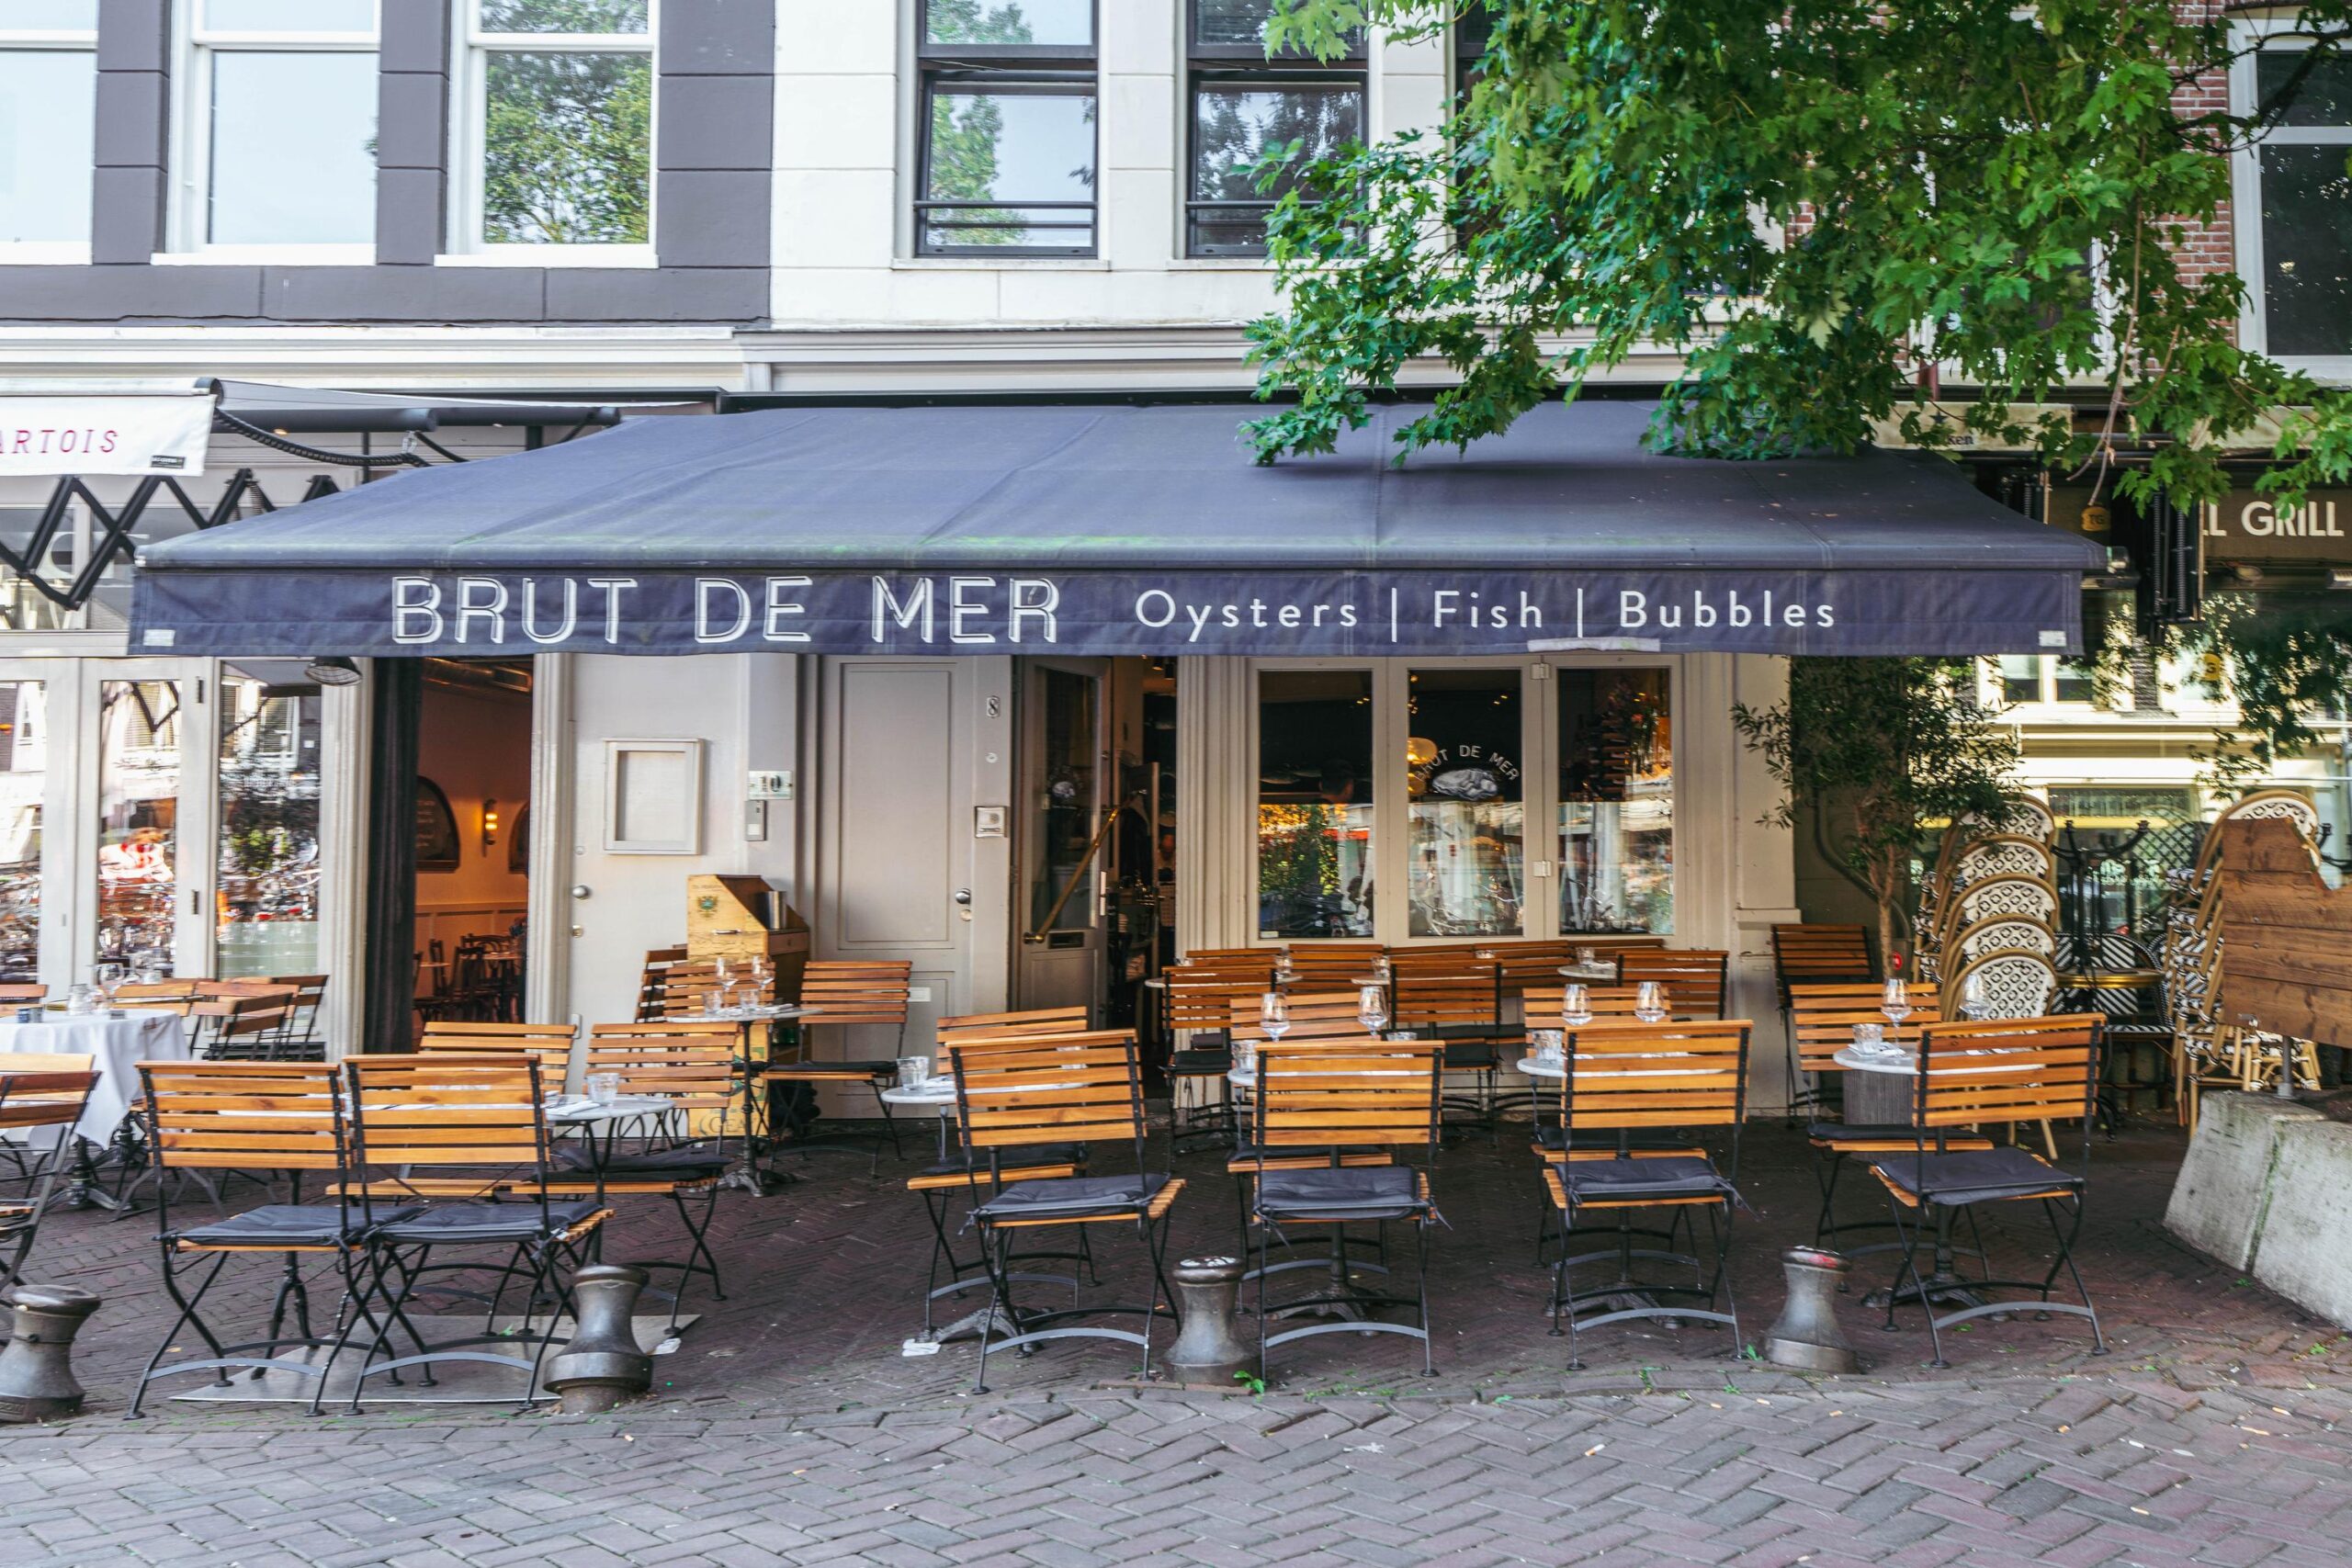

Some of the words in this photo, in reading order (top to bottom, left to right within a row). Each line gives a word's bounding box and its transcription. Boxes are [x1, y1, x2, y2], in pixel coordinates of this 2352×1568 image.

[0, 429, 119, 454] RTOIS
[2202, 502, 2228, 537] L
[2241, 501, 2346, 537] GRILL
[391, 576, 639, 645] BRUT
[695, 576, 813, 644] DE
[871, 576, 1060, 644] MER
[1135, 589, 1358, 643] Oysters
[1434, 589, 1543, 628] Fish
[1619, 589, 1836, 628] Bubbles
[988, 697, 1000, 717] 8
[1459, 744, 1482, 759] DE
[1488, 751, 1520, 781] MER
[759, 774, 782, 793] 10
